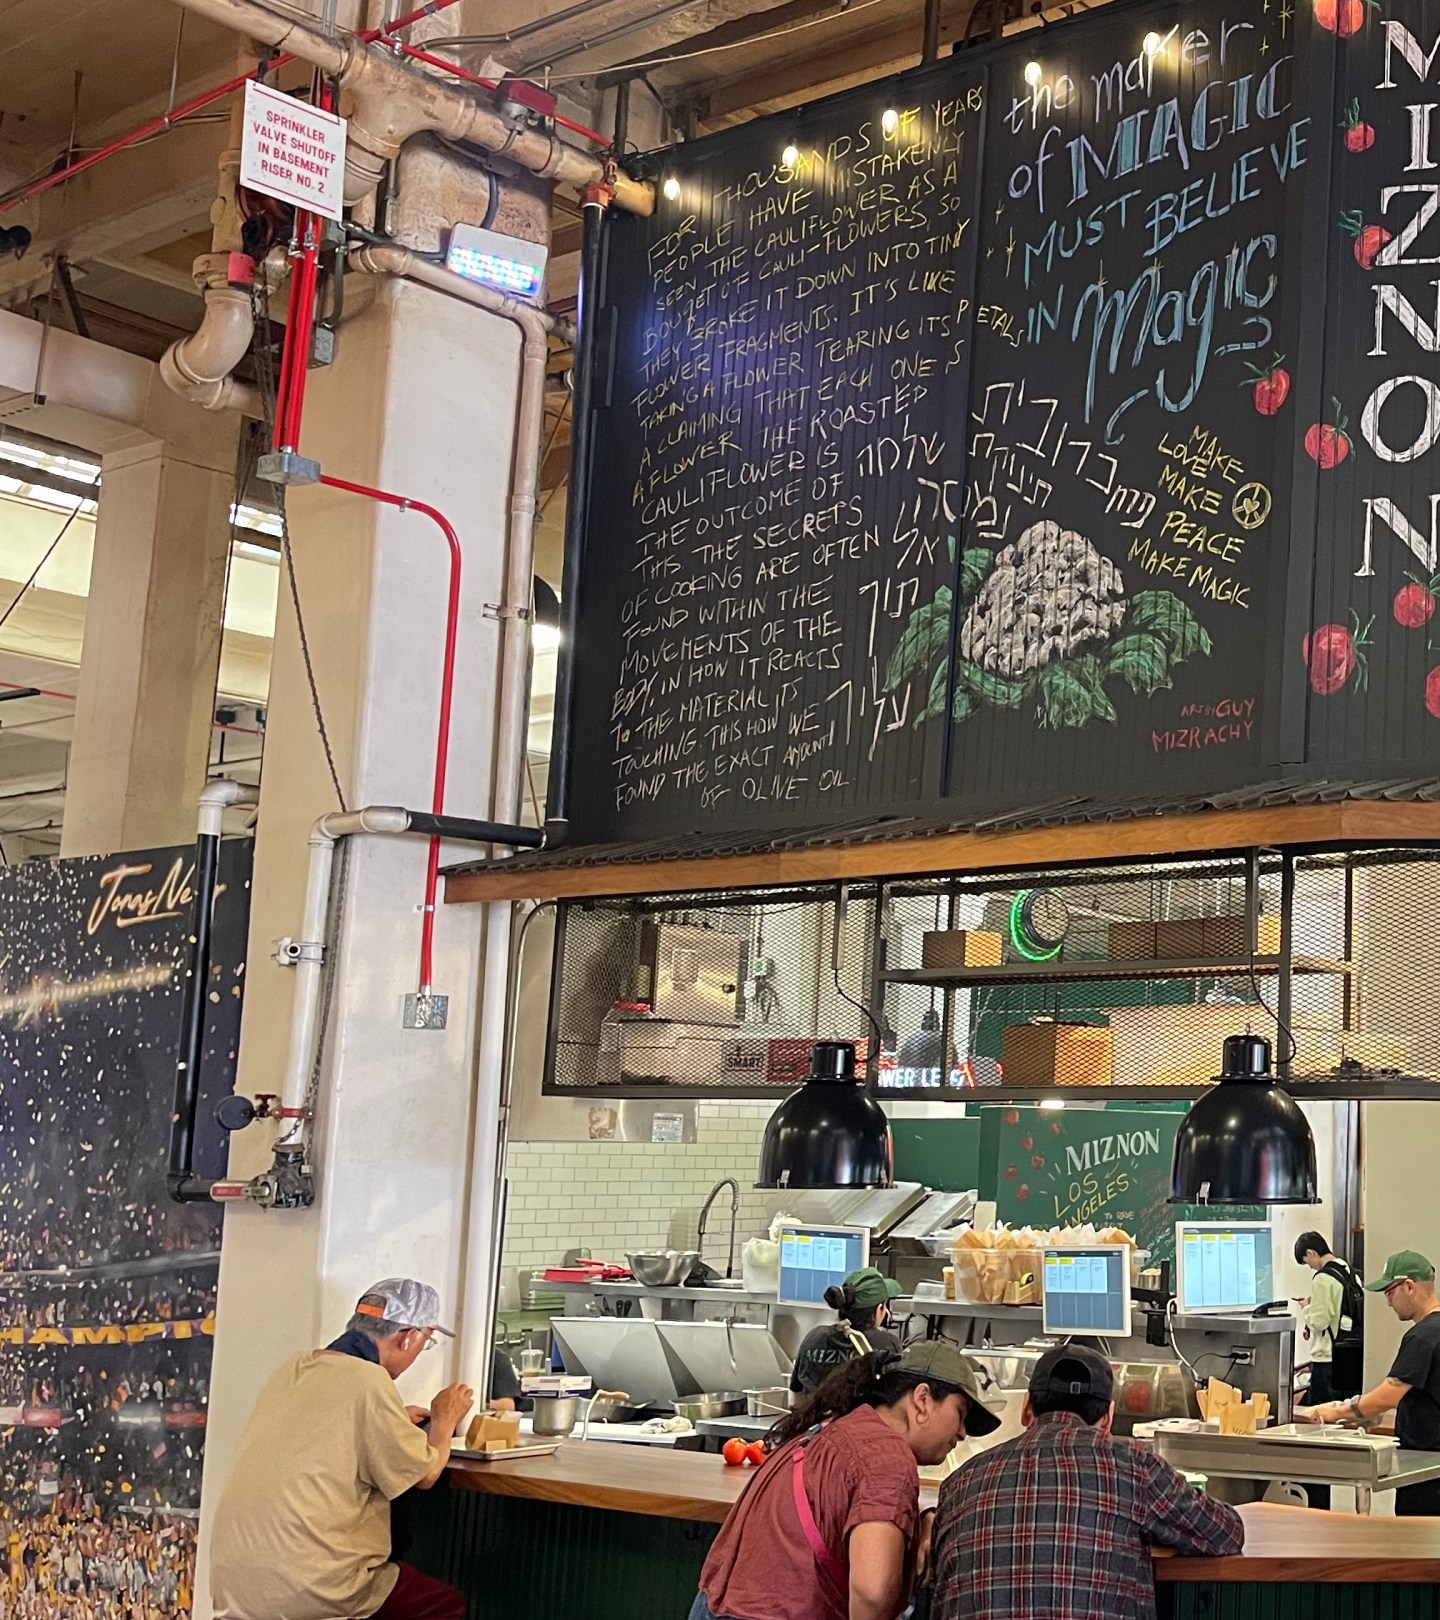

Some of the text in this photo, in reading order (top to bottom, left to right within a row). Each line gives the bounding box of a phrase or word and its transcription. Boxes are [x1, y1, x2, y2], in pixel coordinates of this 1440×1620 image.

[1003, 23, 1254, 134] the maker
[253, 123, 336, 164] VALVE SHUTOFF
[266, 110, 325, 142] SPRINKLER
[1008, 56, 1294, 214] of MAGIC
[258, 142, 330, 178] IN BASEMENT
[261, 160, 324, 193] RISER NO. 2
[647, 214, 697, 273] FOR
[713, 122, 873, 209] THOUSANDS
[882, 109, 920, 142] OF
[652, 132, 965, 291] PEOPLE HAVE MISTAKENLY
[655, 161, 958, 312] SEEN THE CAULIFLOWER AS A
[1024, 117, 1312, 291] MUST BELIEVE
[641, 218, 970, 383] THEY BROKE IT DOWN INTO TINY
[1027, 284, 1063, 344] IN
[632, 352, 710, 418] FLOWER
[851, 280, 898, 315] IT'S
[908, 270, 956, 294] LIKE
[702, 378, 715, 398] A
[723, 351, 805, 398] FLOWER
[815, 319, 910, 367] TEARING
[918, 315, 951, 336] ITS
[755, 385, 811, 414] THAT
[819, 363, 873, 401] EACH
[890, 357, 938, 380] ONE
[632, 385, 928, 507] A FLOWER THE ROASTED
[1158, 432, 1209, 478] LOVE
[1188, 425, 1244, 484] MAKE
[636, 472, 844, 555] THE OUTCOME OF
[641, 442, 839, 525] CAULIFLOWER IS
[1158, 465, 1222, 516] MAKE
[693, 496, 863, 565] THE SECRETS
[1159, 510, 1244, 563] PEACE
[622, 525, 879, 623] OF COOKING ARE OFTEN
[1128, 538, 1251, 608] MAKE MAGIC
[620, 610, 842, 685] MOVEMENTS OF THE
[623, 580, 832, 654] FOUND WITHIN THE
[661, 671, 682, 696] IN
[688, 660, 729, 688] HOW
[740, 655, 761, 680] IT
[767, 643, 844, 675] REACTS
[1152, 720, 1254, 752] MIZRACHY
[1216, 697, 1254, 717] GUY
[612, 745, 774, 811] FOUND THE EXACT
[701, 769, 849, 810] OF OLIVE OIL
[1064, 1129, 1161, 1176] MIZNON
[1054, 1172, 1099, 1219] LOS
[1062, 1173, 1130, 1229] ANGELES
